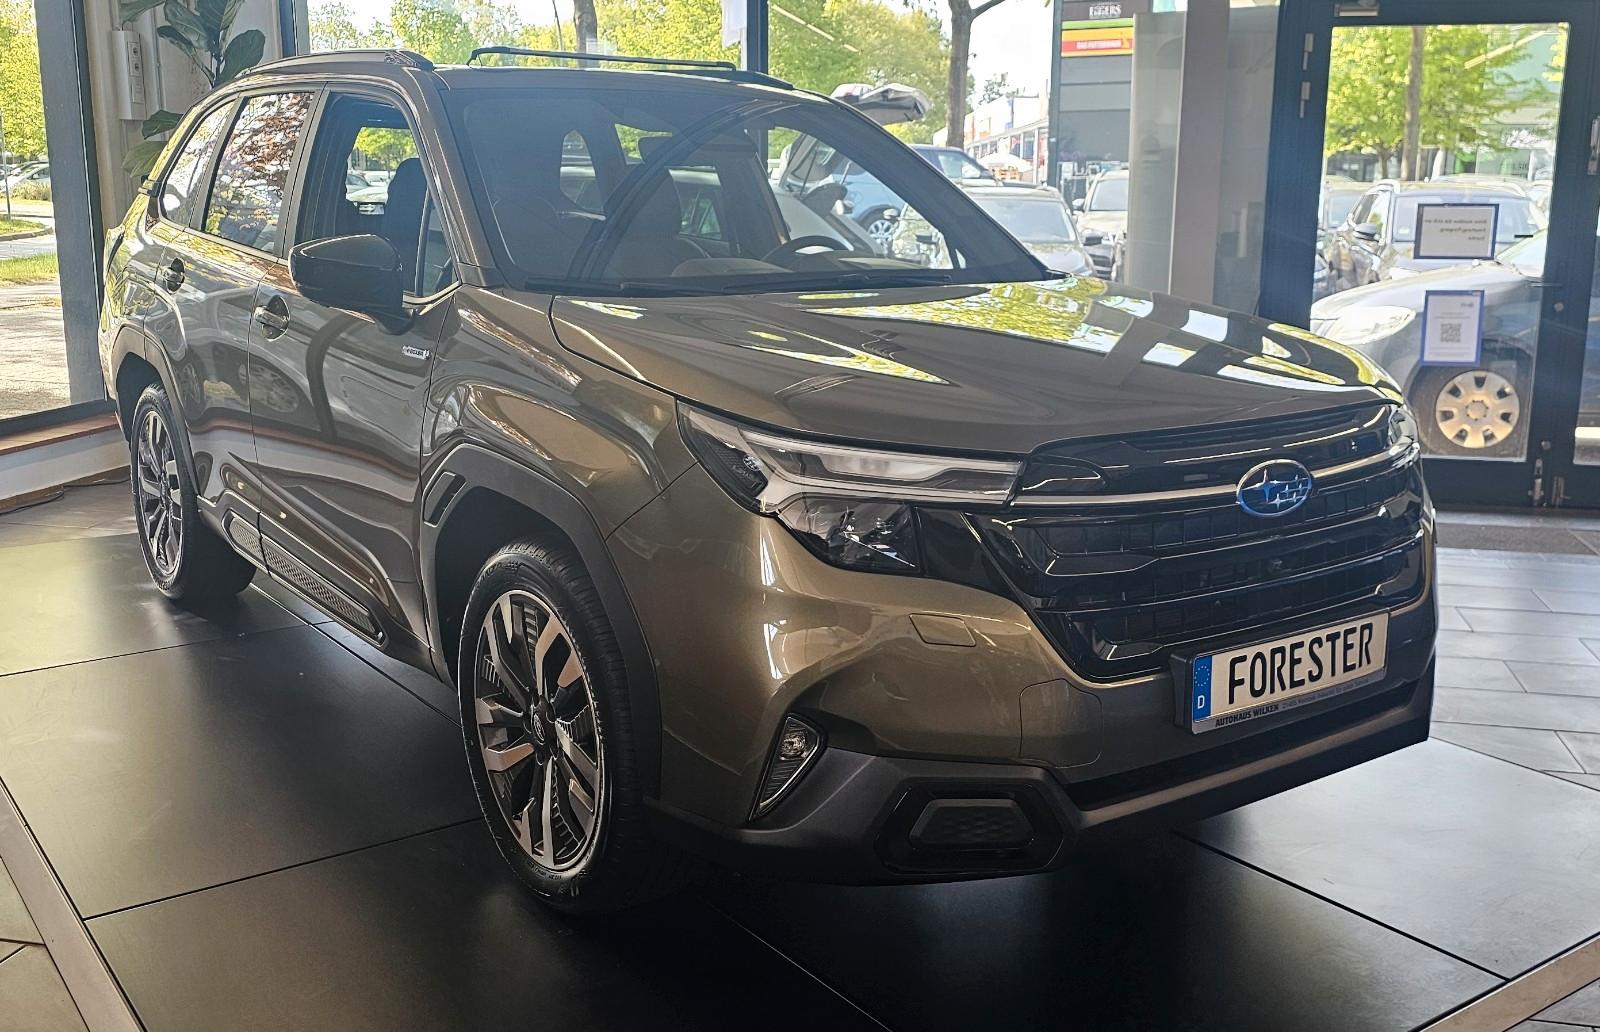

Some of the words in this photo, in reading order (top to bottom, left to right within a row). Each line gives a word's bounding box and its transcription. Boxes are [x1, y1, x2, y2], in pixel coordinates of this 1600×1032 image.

[1228, 622, 1373, 704] FORESTER
[1197, 694, 1206, 709] D
[1215, 711, 1252, 727] AUTOHAUS
[1253, 705, 1279, 718] WILKEN
